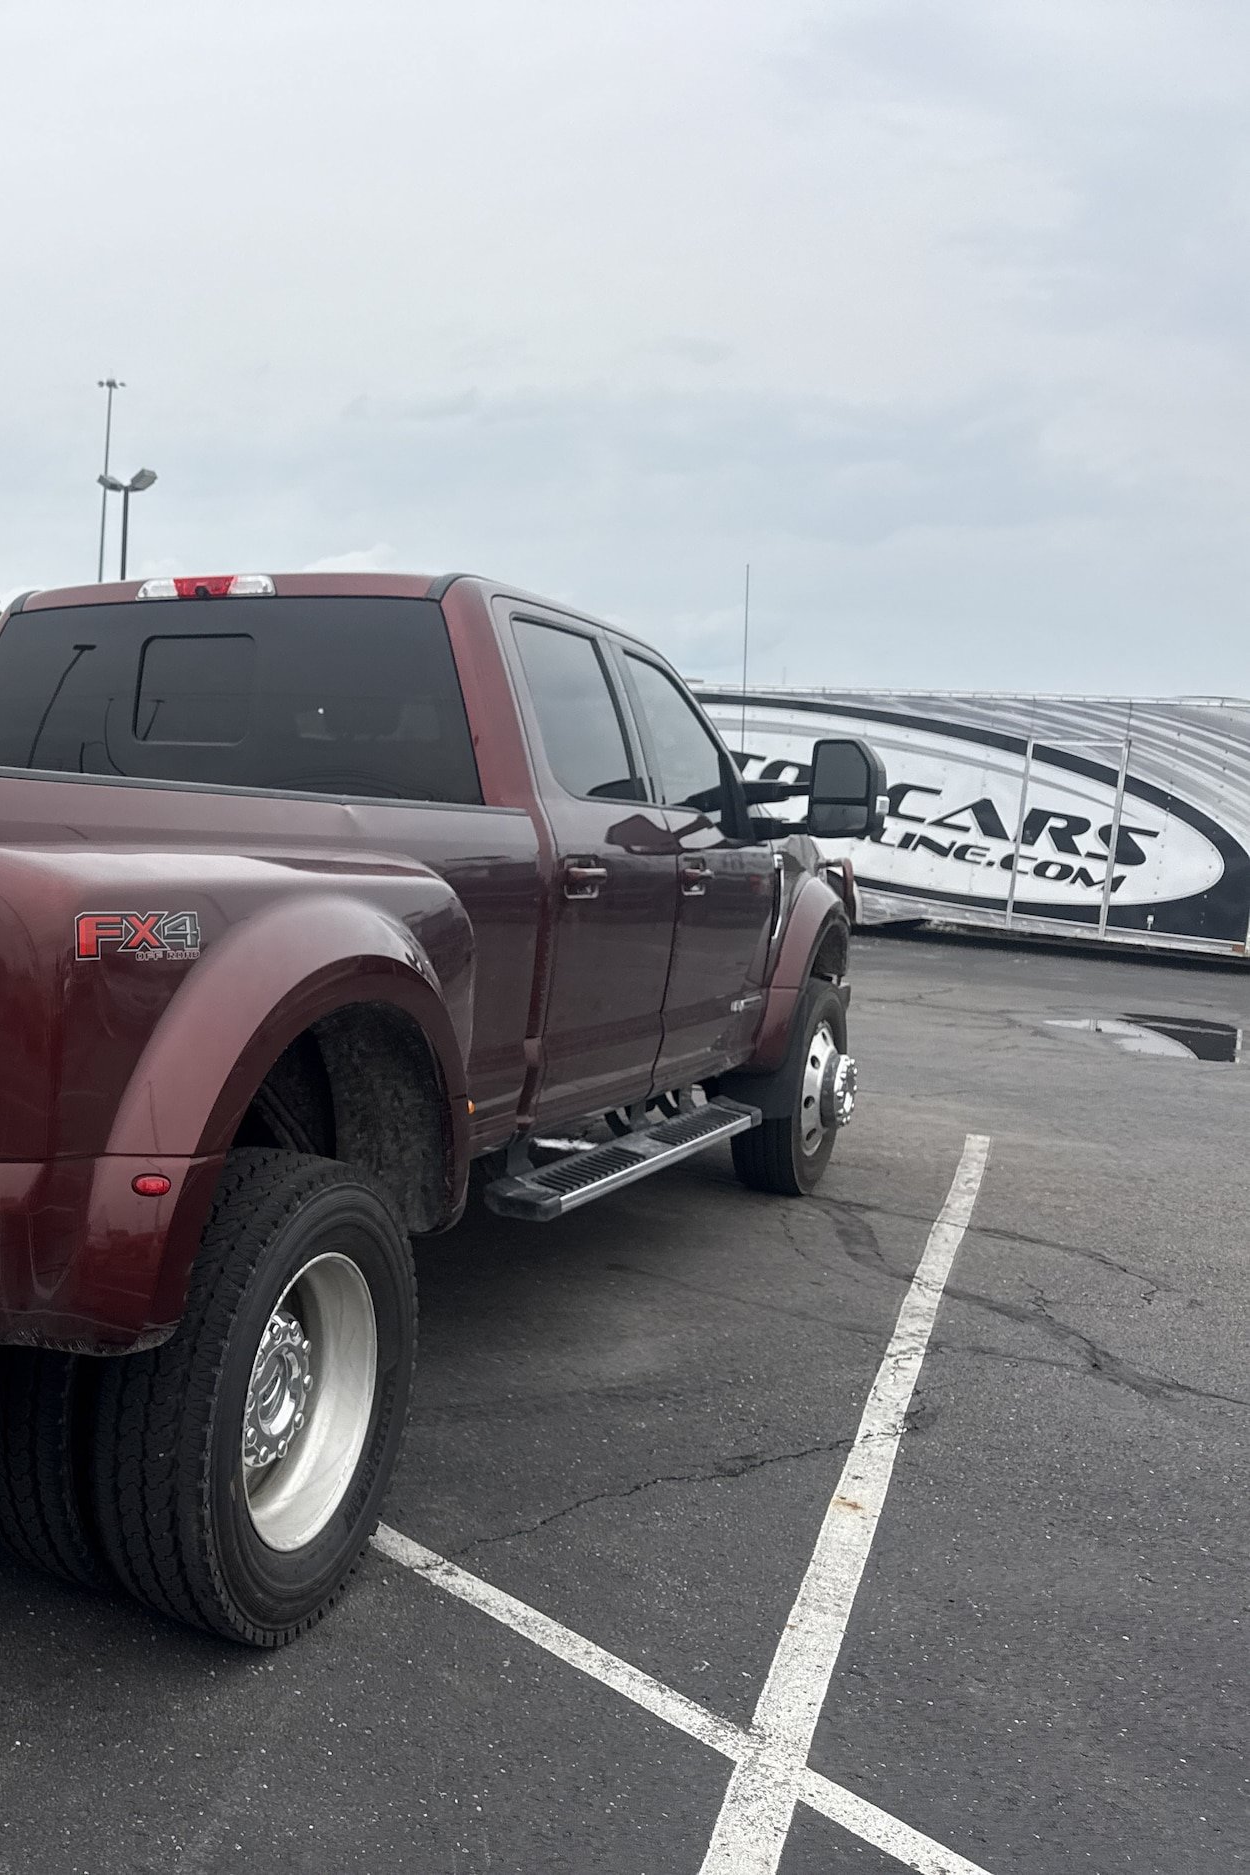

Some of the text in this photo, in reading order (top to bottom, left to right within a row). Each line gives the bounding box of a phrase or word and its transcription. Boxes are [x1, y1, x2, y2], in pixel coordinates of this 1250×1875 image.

[858, 826, 1127, 893] LINE.COM
[75, 911, 201, 961] FX4
[135, 950, 164, 962] OFF
